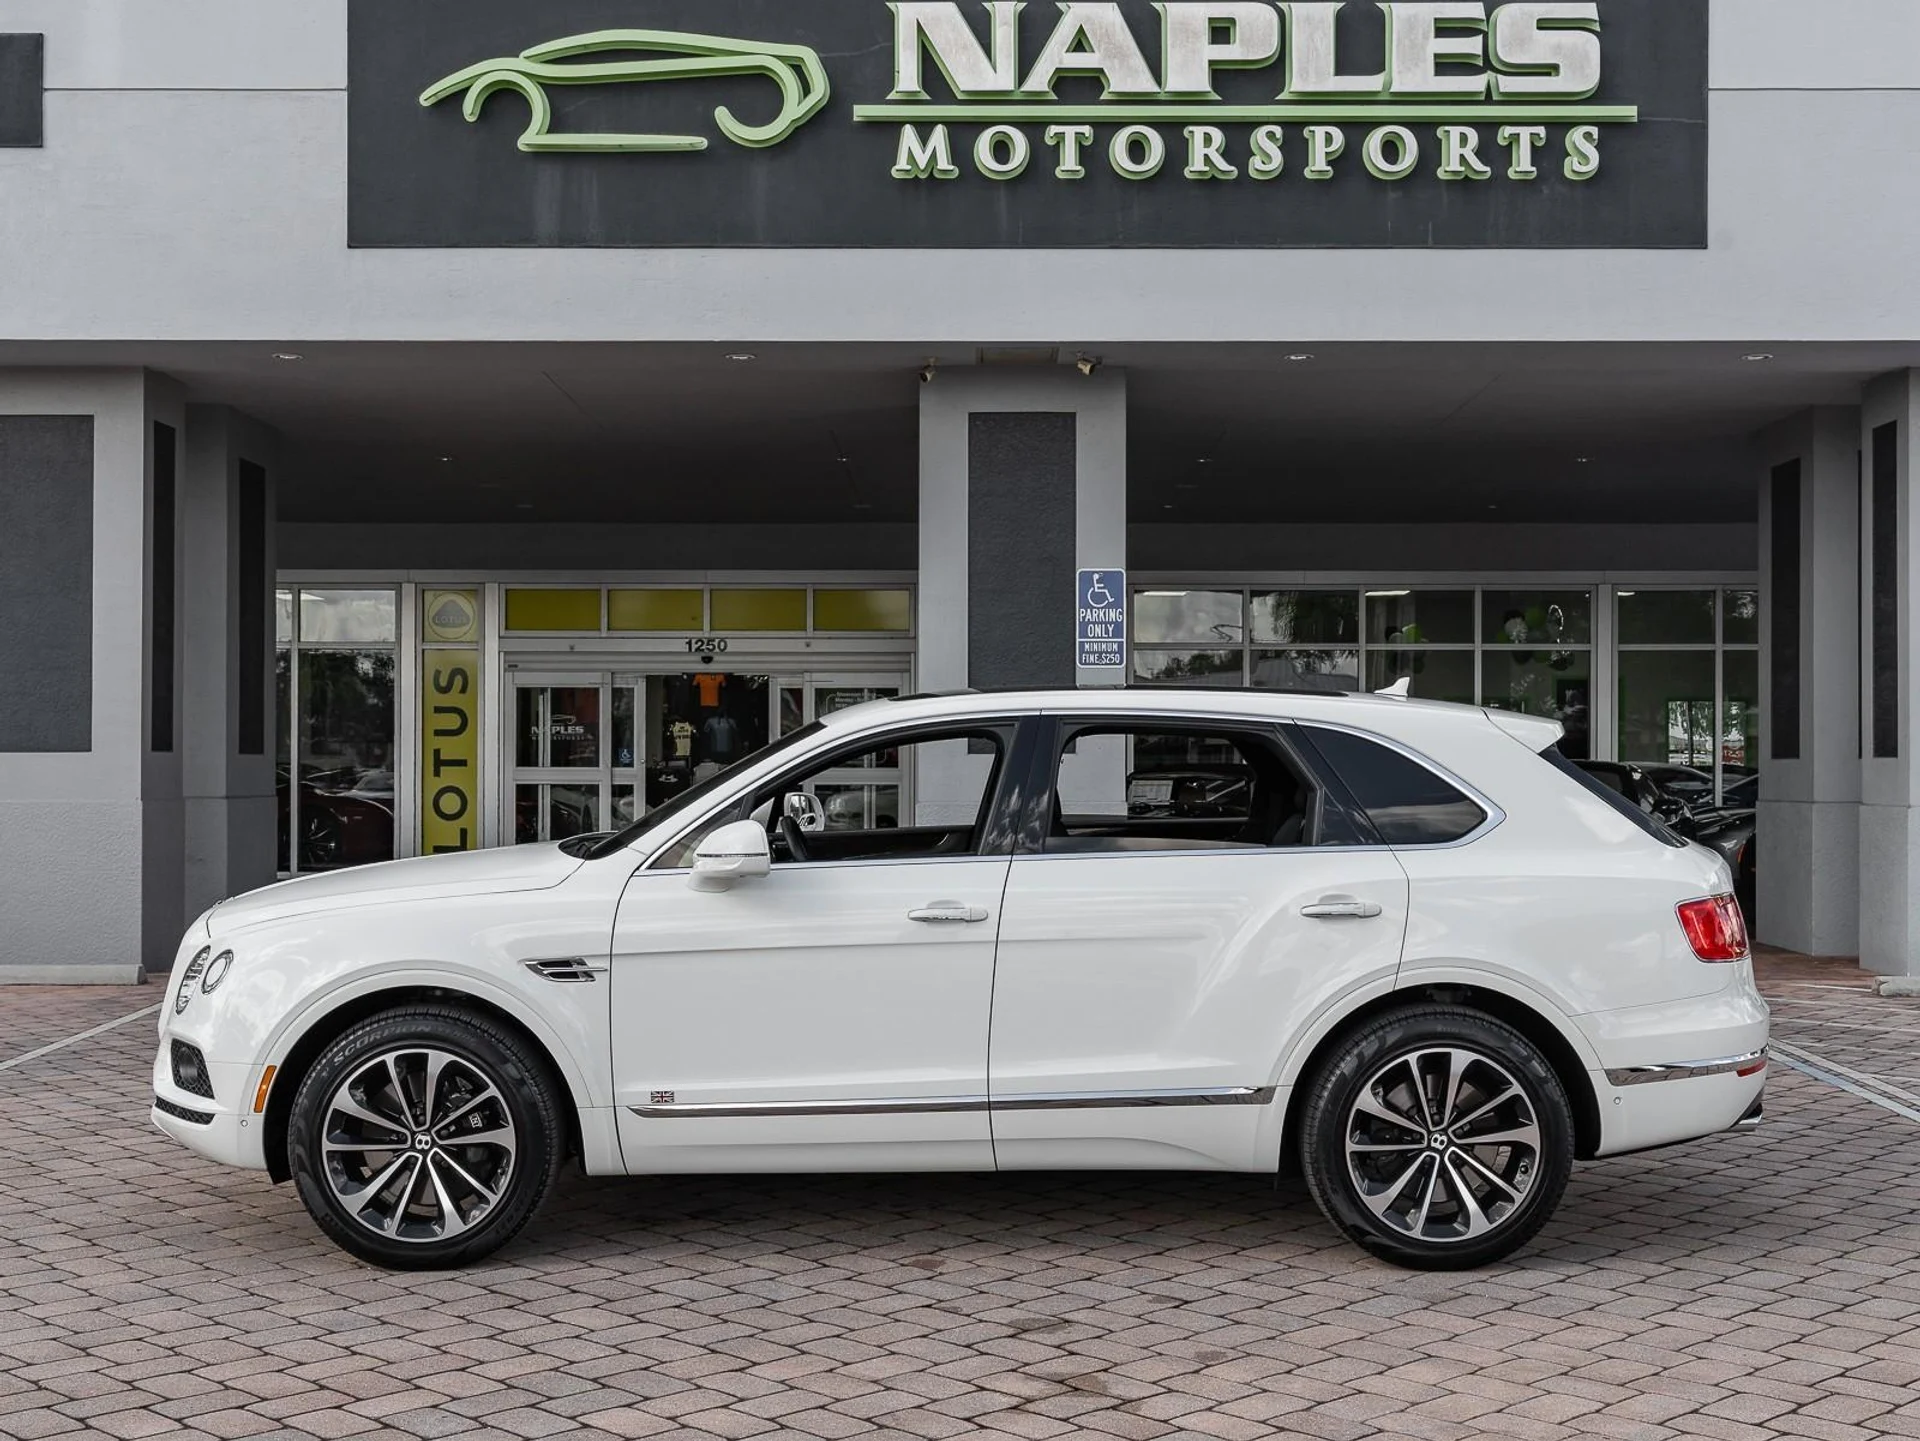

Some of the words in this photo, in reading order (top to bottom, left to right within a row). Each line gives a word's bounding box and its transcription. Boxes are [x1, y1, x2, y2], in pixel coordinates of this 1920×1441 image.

[886, 2, 1600, 99] NAPLES
[891, 124, 1600, 180] MOTORSPORTS
[1080, 608, 1122, 621] PARKING
[1087, 624, 1114, 637] ONLY
[685, 638, 728, 652] 1250
[1084, 642, 1118, 652] MINIMUM
[1082, 653, 1099, 663] FINE
[531, 726, 584, 734] NPLES
[433, 667, 469, 854] LOTUS
